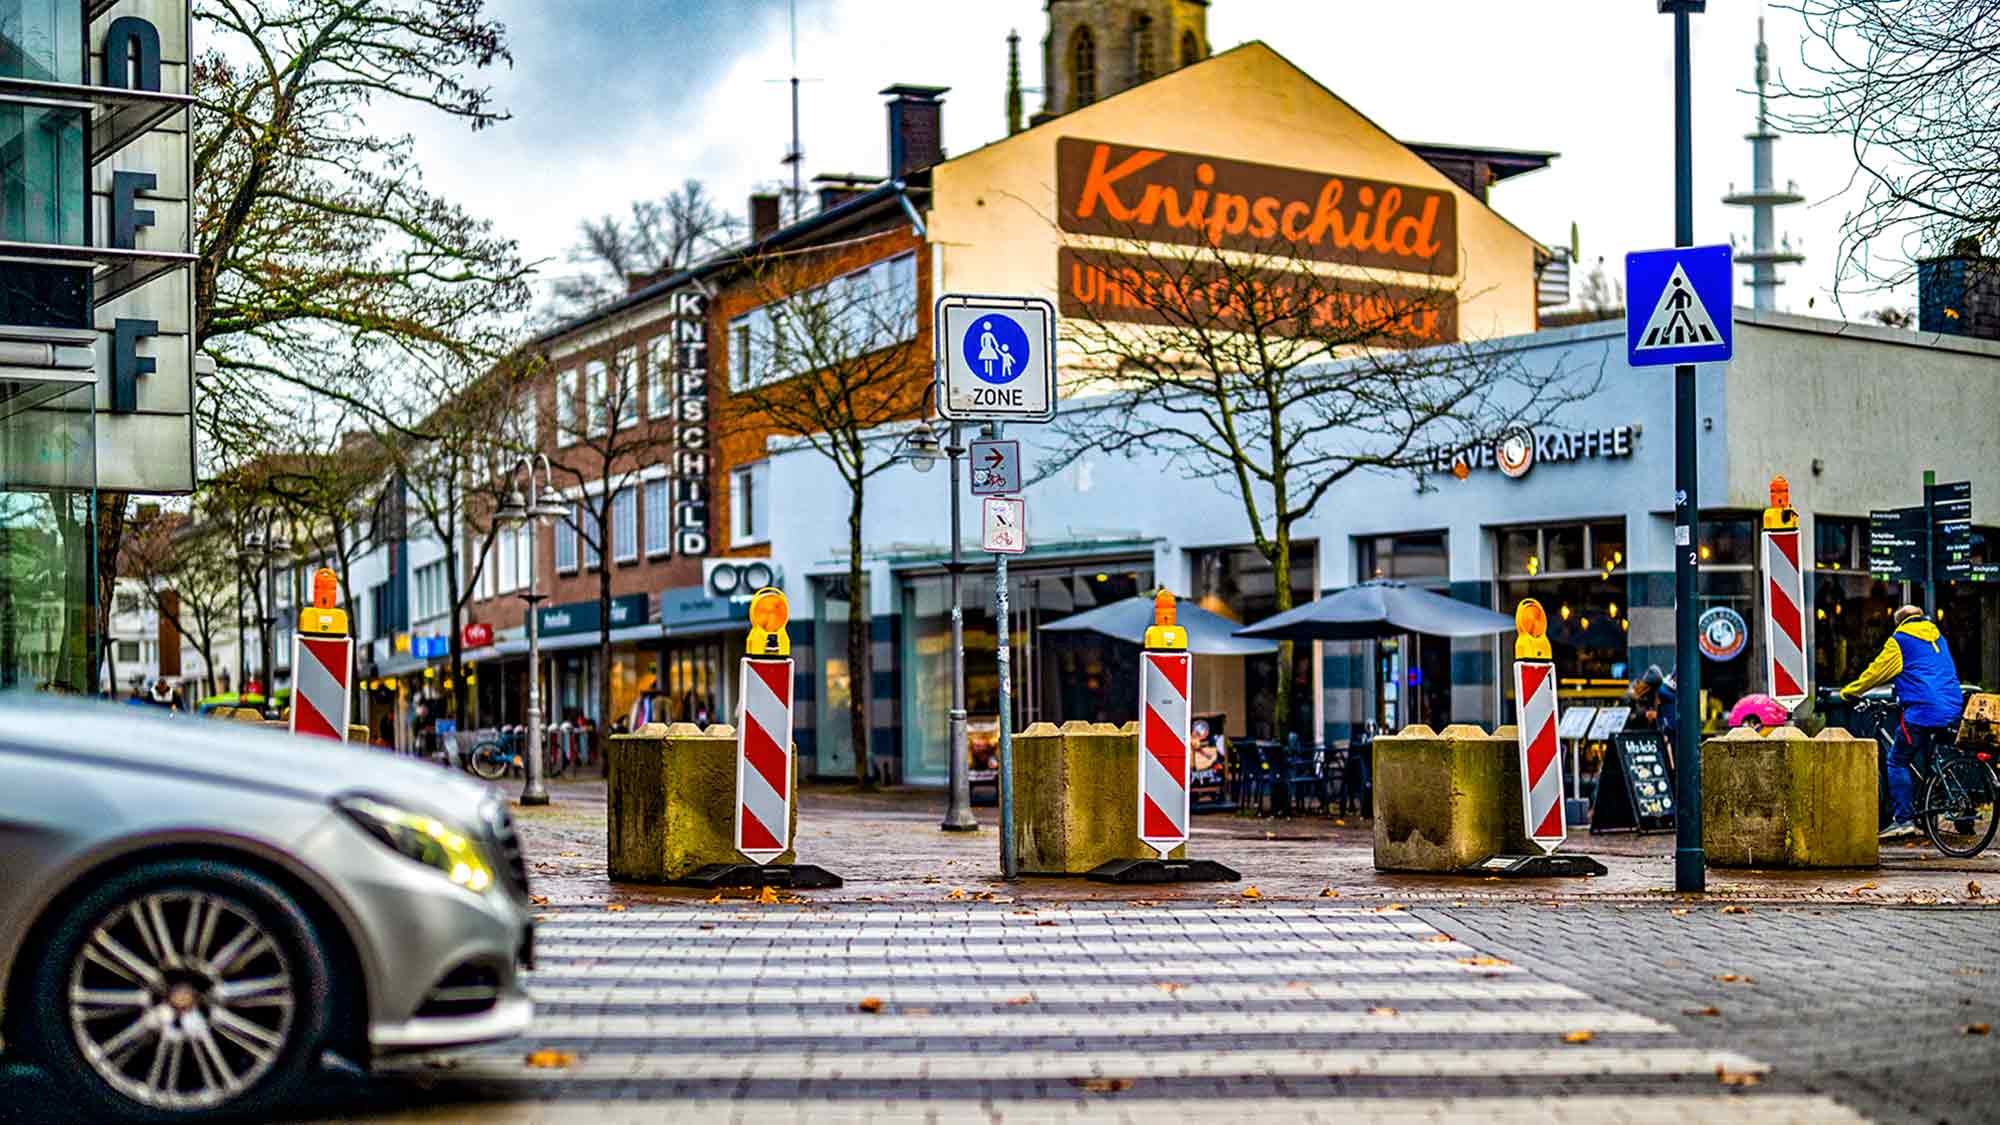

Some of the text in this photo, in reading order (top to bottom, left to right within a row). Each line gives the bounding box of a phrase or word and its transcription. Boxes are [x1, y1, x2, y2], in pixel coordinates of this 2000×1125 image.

[1076, 144, 1441, 258] Knipschild
[973, 388, 1023, 406] ZONE
[679, 293, 706, 554] KNIPSCHILD
[1535, 426, 1629, 462] KAFFEE
[1689, 552, 1697, 565] 2
